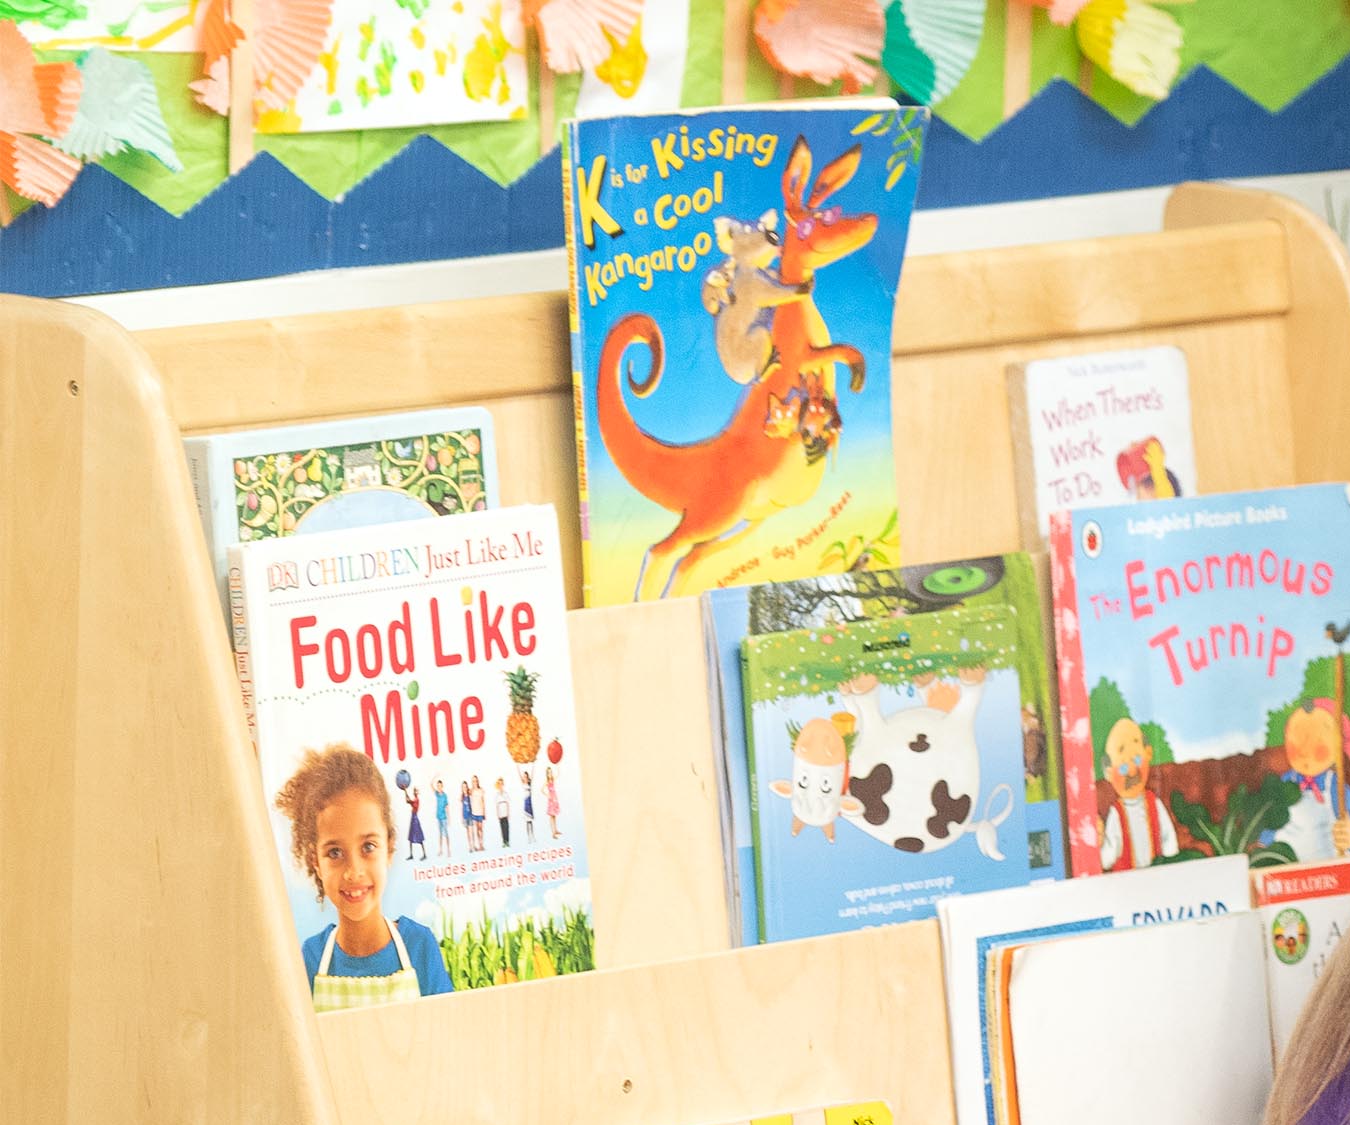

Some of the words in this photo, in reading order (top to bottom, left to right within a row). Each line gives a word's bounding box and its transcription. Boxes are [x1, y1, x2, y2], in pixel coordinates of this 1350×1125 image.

[577, 154, 624, 249] K
[610, 168, 624, 188] is
[625, 163, 649, 184] for
[651, 125, 779, 179] Kissing
[633, 207, 649, 226] a
[653, 171, 724, 231] Cool
[584, 231, 712, 307] Kangaroo
[1041, 397, 1097, 431] When
[1095, 385, 1165, 417] There's
[1051, 430, 1104, 468] Work
[1048, 477, 1073, 506] To
[1074, 471, 1103, 498] Do
[1127, 510, 1192, 539] Ladybird
[1194, 508, 1243, 529] Picture
[1246, 504, 1289, 524] Books
[306, 545, 422, 587] CHILDREN
[424, 543, 461, 578] Just
[465, 534, 509, 566] Like
[512, 529, 544, 559] Me
[1089, 592, 1121, 621] The
[1124, 548, 1334, 620] Enormous
[290, 600, 416, 689] Food
[429, 585, 537, 668] Like
[1148, 614, 1296, 687] Turnip
[360, 680, 486, 764] Mine
[414, 862, 467, 882] Includes
[471, 854, 523, 874] amazing
[527, 846, 574, 864] recipes
[435, 882, 466, 898] from
[469, 874, 514, 894] around
[516, 870, 537, 886] the
[540, 864, 574, 882] world
